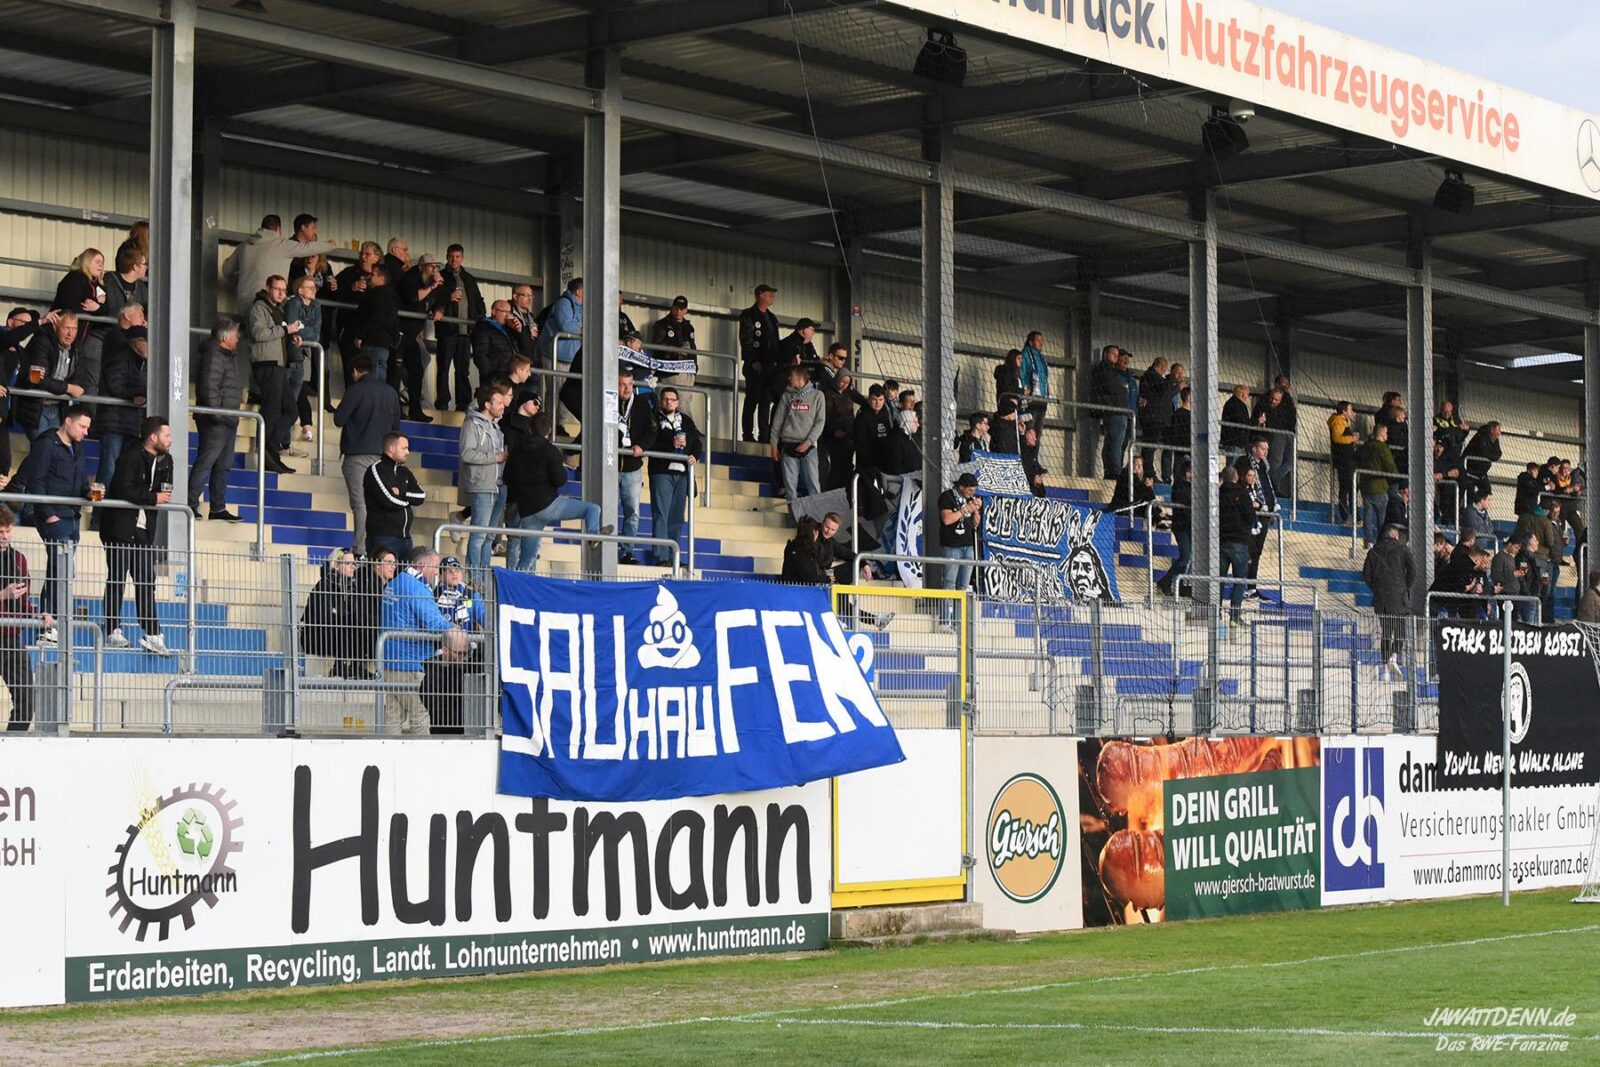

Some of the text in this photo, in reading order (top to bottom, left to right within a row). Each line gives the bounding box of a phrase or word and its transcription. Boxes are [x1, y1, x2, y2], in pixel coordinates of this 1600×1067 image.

[1180, 0, 1521, 153] Nutzfahrzeugservice
[848, 633, 874, 675] 2
[1441, 626, 1486, 655] STARK
[1488, 628, 1542, 656] BLIBEN
[501, 603, 888, 761] SAU FEN
[628, 685, 718, 761] HAU
[1443, 749, 1585, 776] YOU'LL NEVR WALK ALONE
[1172, 784, 1279, 827] DEIN GRILL
[1556, 804, 1595, 830] GmbH
[0, 837, 35, 867] bH
[291, 765, 812, 934] Huntmann
[991, 810, 1060, 868] Giersch
[1172, 816, 1317, 871] WILL QUALITÄT
[129, 866, 238, 897] Huntmann
[1194, 872, 1316, 900] www.giersch-bratwurst.de
[1413, 851, 1589, 886] www.dammros-assekuranz.de
[89, 921, 806, 993] Erdarbeiten, Recycling, Landt. Lohnunternehmen www.huntmann.de
